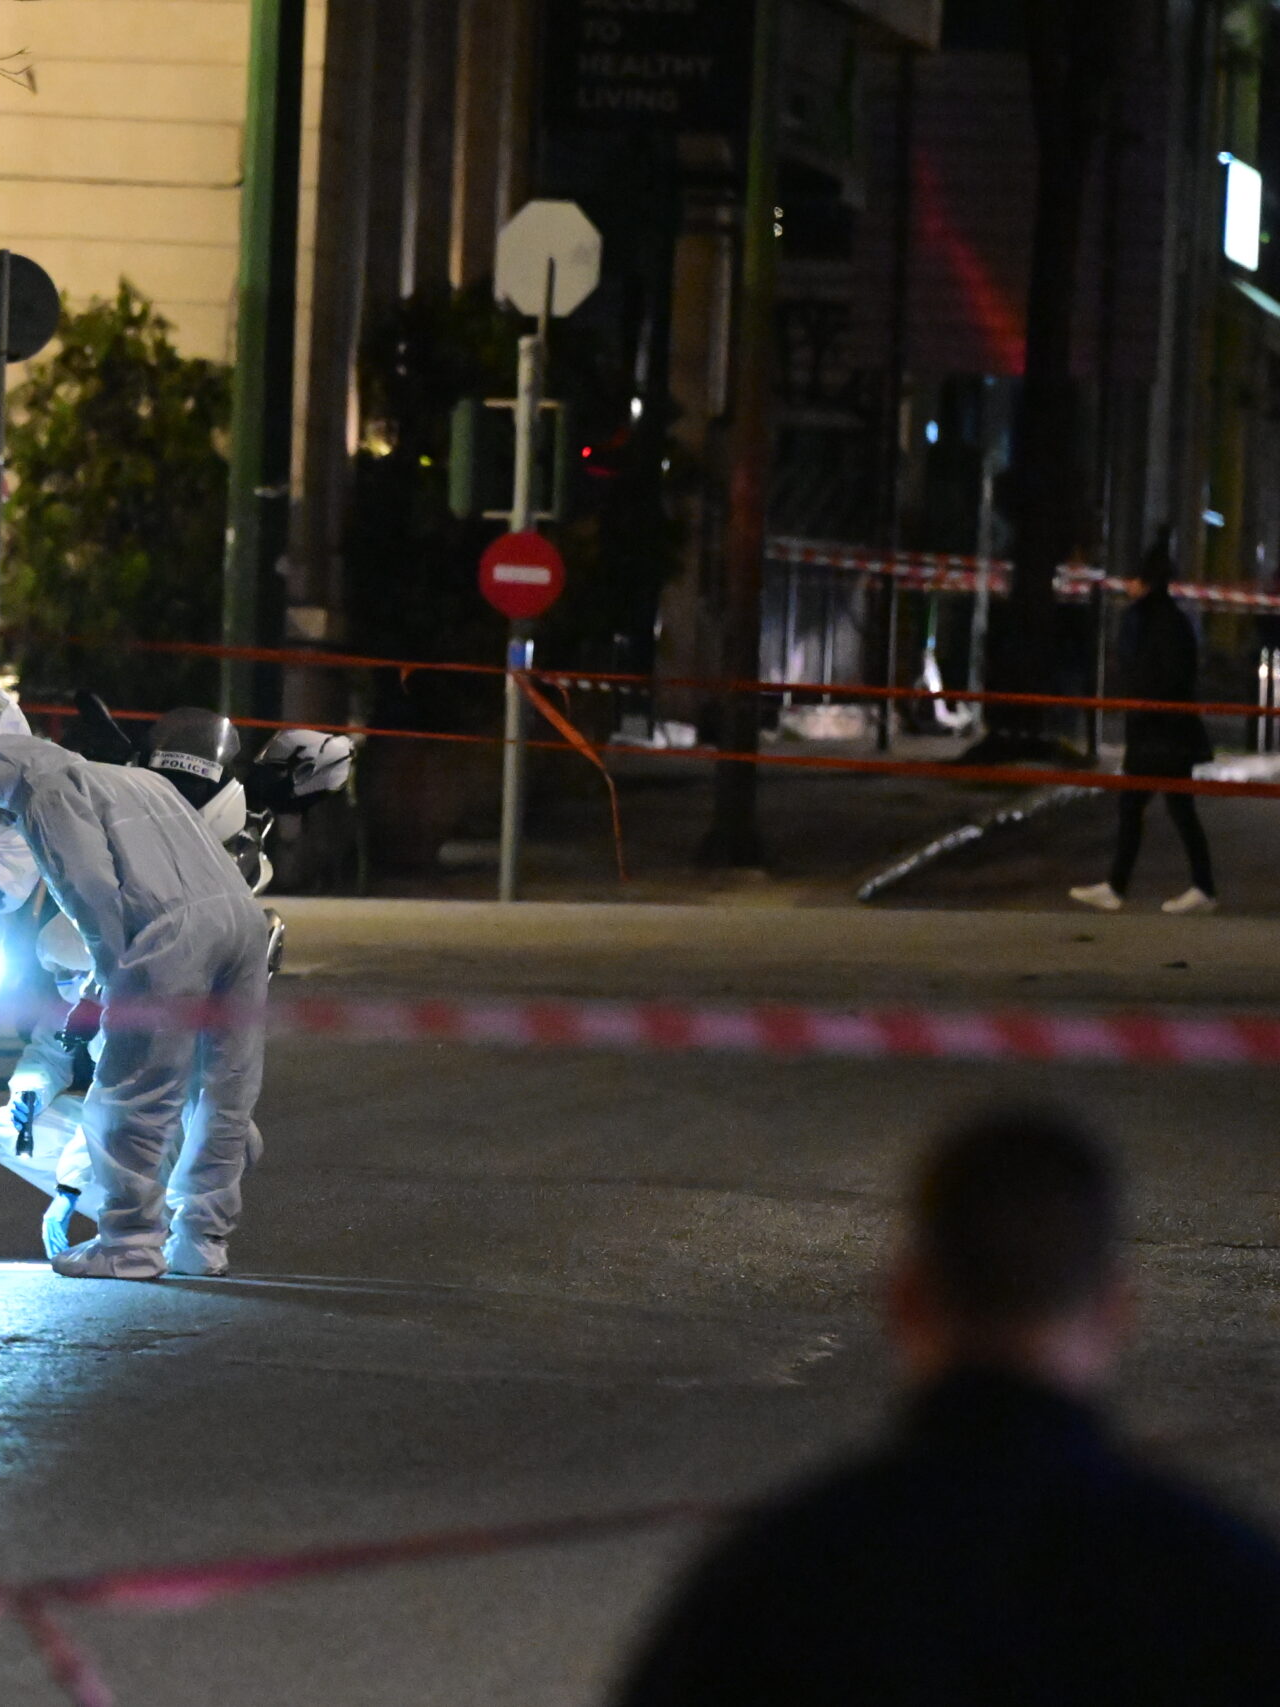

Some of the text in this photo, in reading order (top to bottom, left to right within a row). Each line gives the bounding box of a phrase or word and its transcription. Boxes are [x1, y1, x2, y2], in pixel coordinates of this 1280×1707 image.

[583, 19, 622, 43] TO
[577, 53, 713, 79] HEALTHY
[577, 86, 678, 111] LIVING
[161, 760, 209, 776] POLICE
